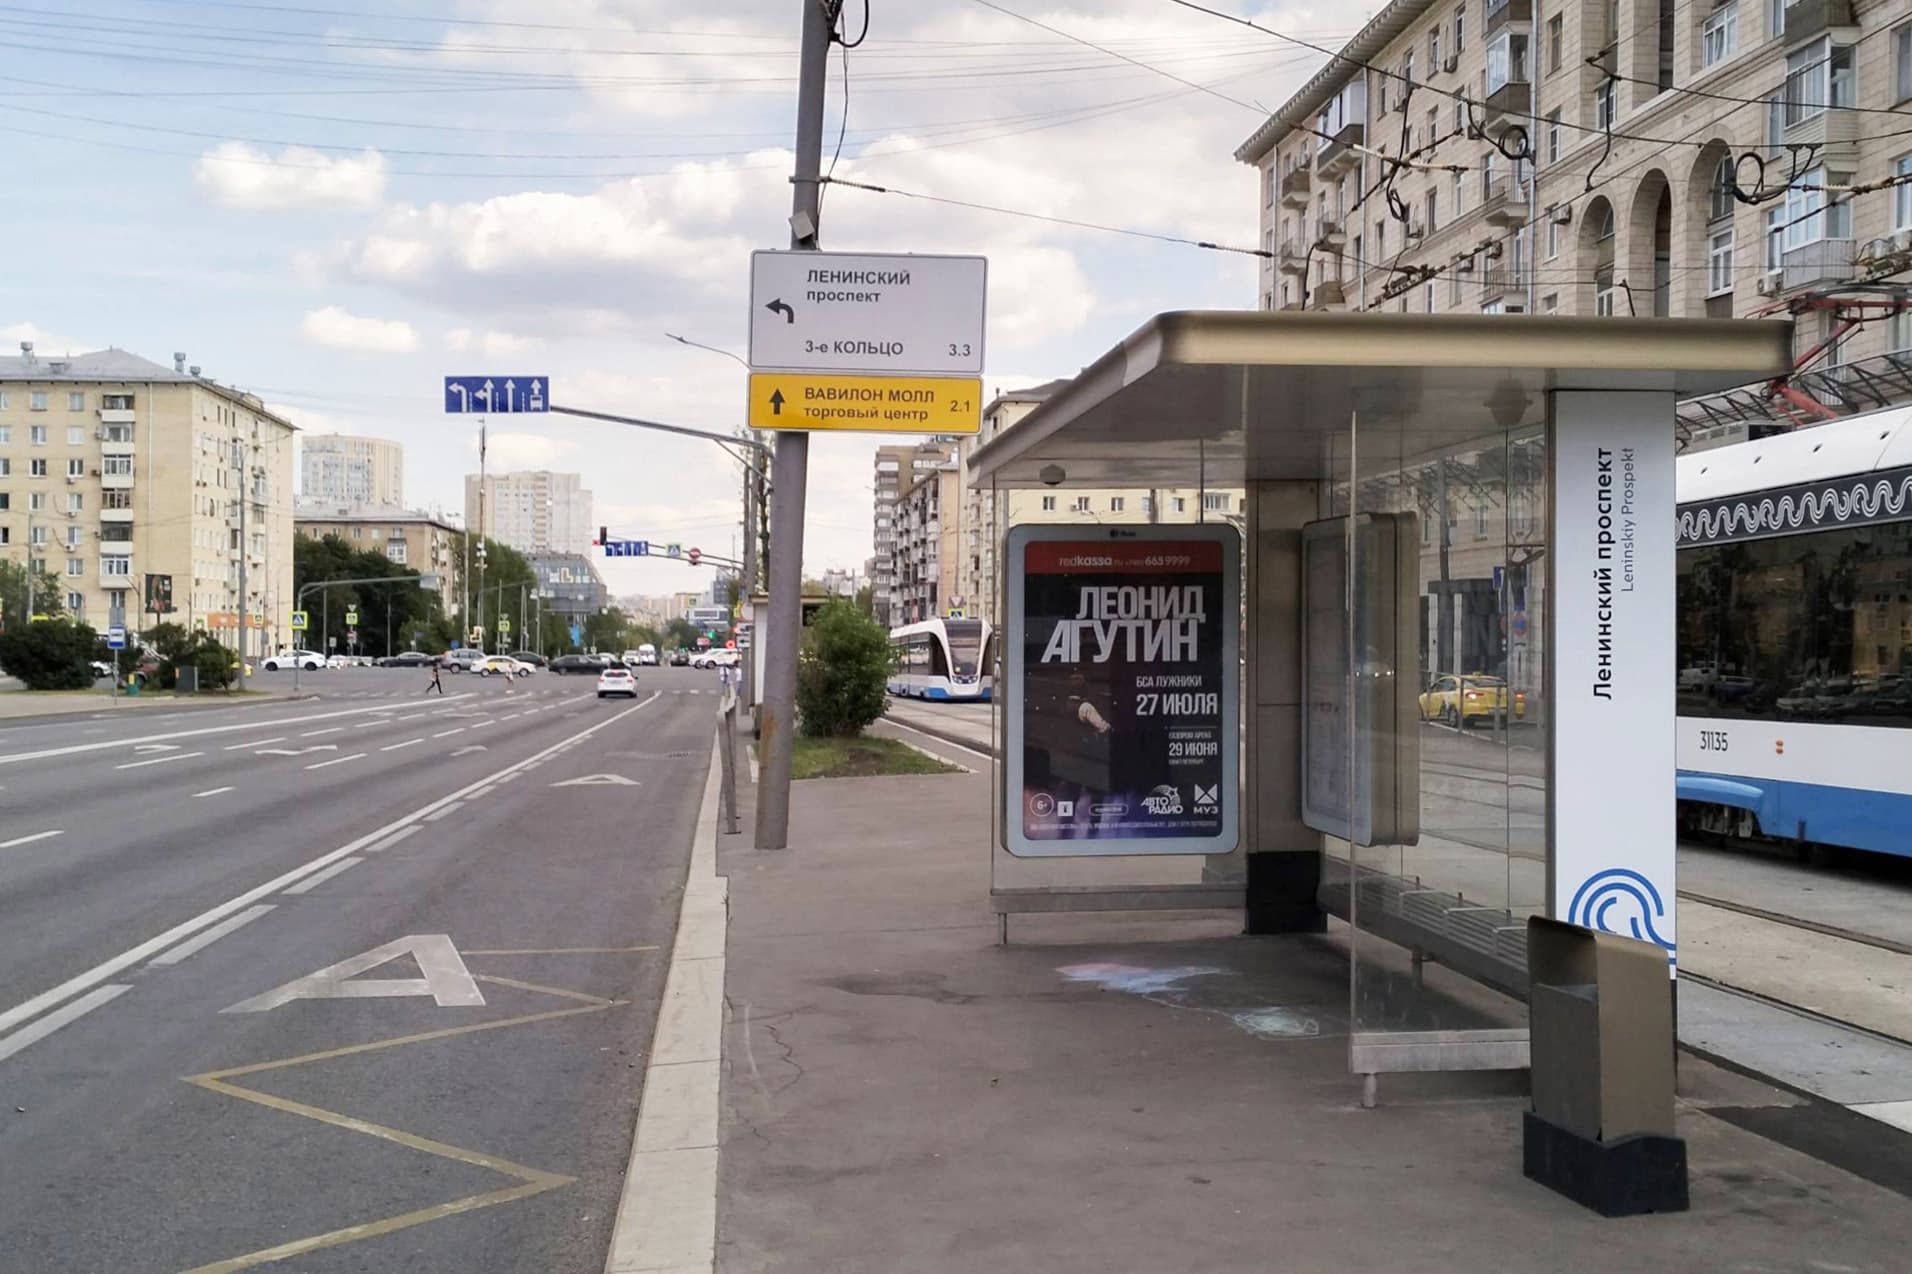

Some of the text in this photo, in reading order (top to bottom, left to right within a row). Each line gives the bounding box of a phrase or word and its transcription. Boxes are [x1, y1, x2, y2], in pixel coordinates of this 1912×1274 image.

[807, 269, 911, 285] ЛЕНИНСКИЙ
[806, 290, 881, 304] проспект
[805, 340, 971, 357] 3-е КОЛЬЦО 3.3
[804, 387, 935, 403] ВАВИЛОН МОЛЛ
[804, 406, 928, 423] торговый центр
[950, 400, 971, 413] 2.1
[1621, 448, 1637, 592] Leninskiy Prospekt
[1593, 447, 1616, 700] Ленинский проспект
[1075, 585, 1206, 623] ЛЕОНИД
[1040, 619, 1198, 663] АГУТИН
[1136, 674, 1202, 688] БСА ЛУЖНИКИ
[1136, 693, 1218, 716] 27 ИЮЛЯ
[1700, 730, 1728, 751] 31135
[1168, 742, 1218, 756] 29 ИЮНЯ
[1141, 797, 1169, 807] АВТО
[1148, 804, 1184, 815] РАДИО
